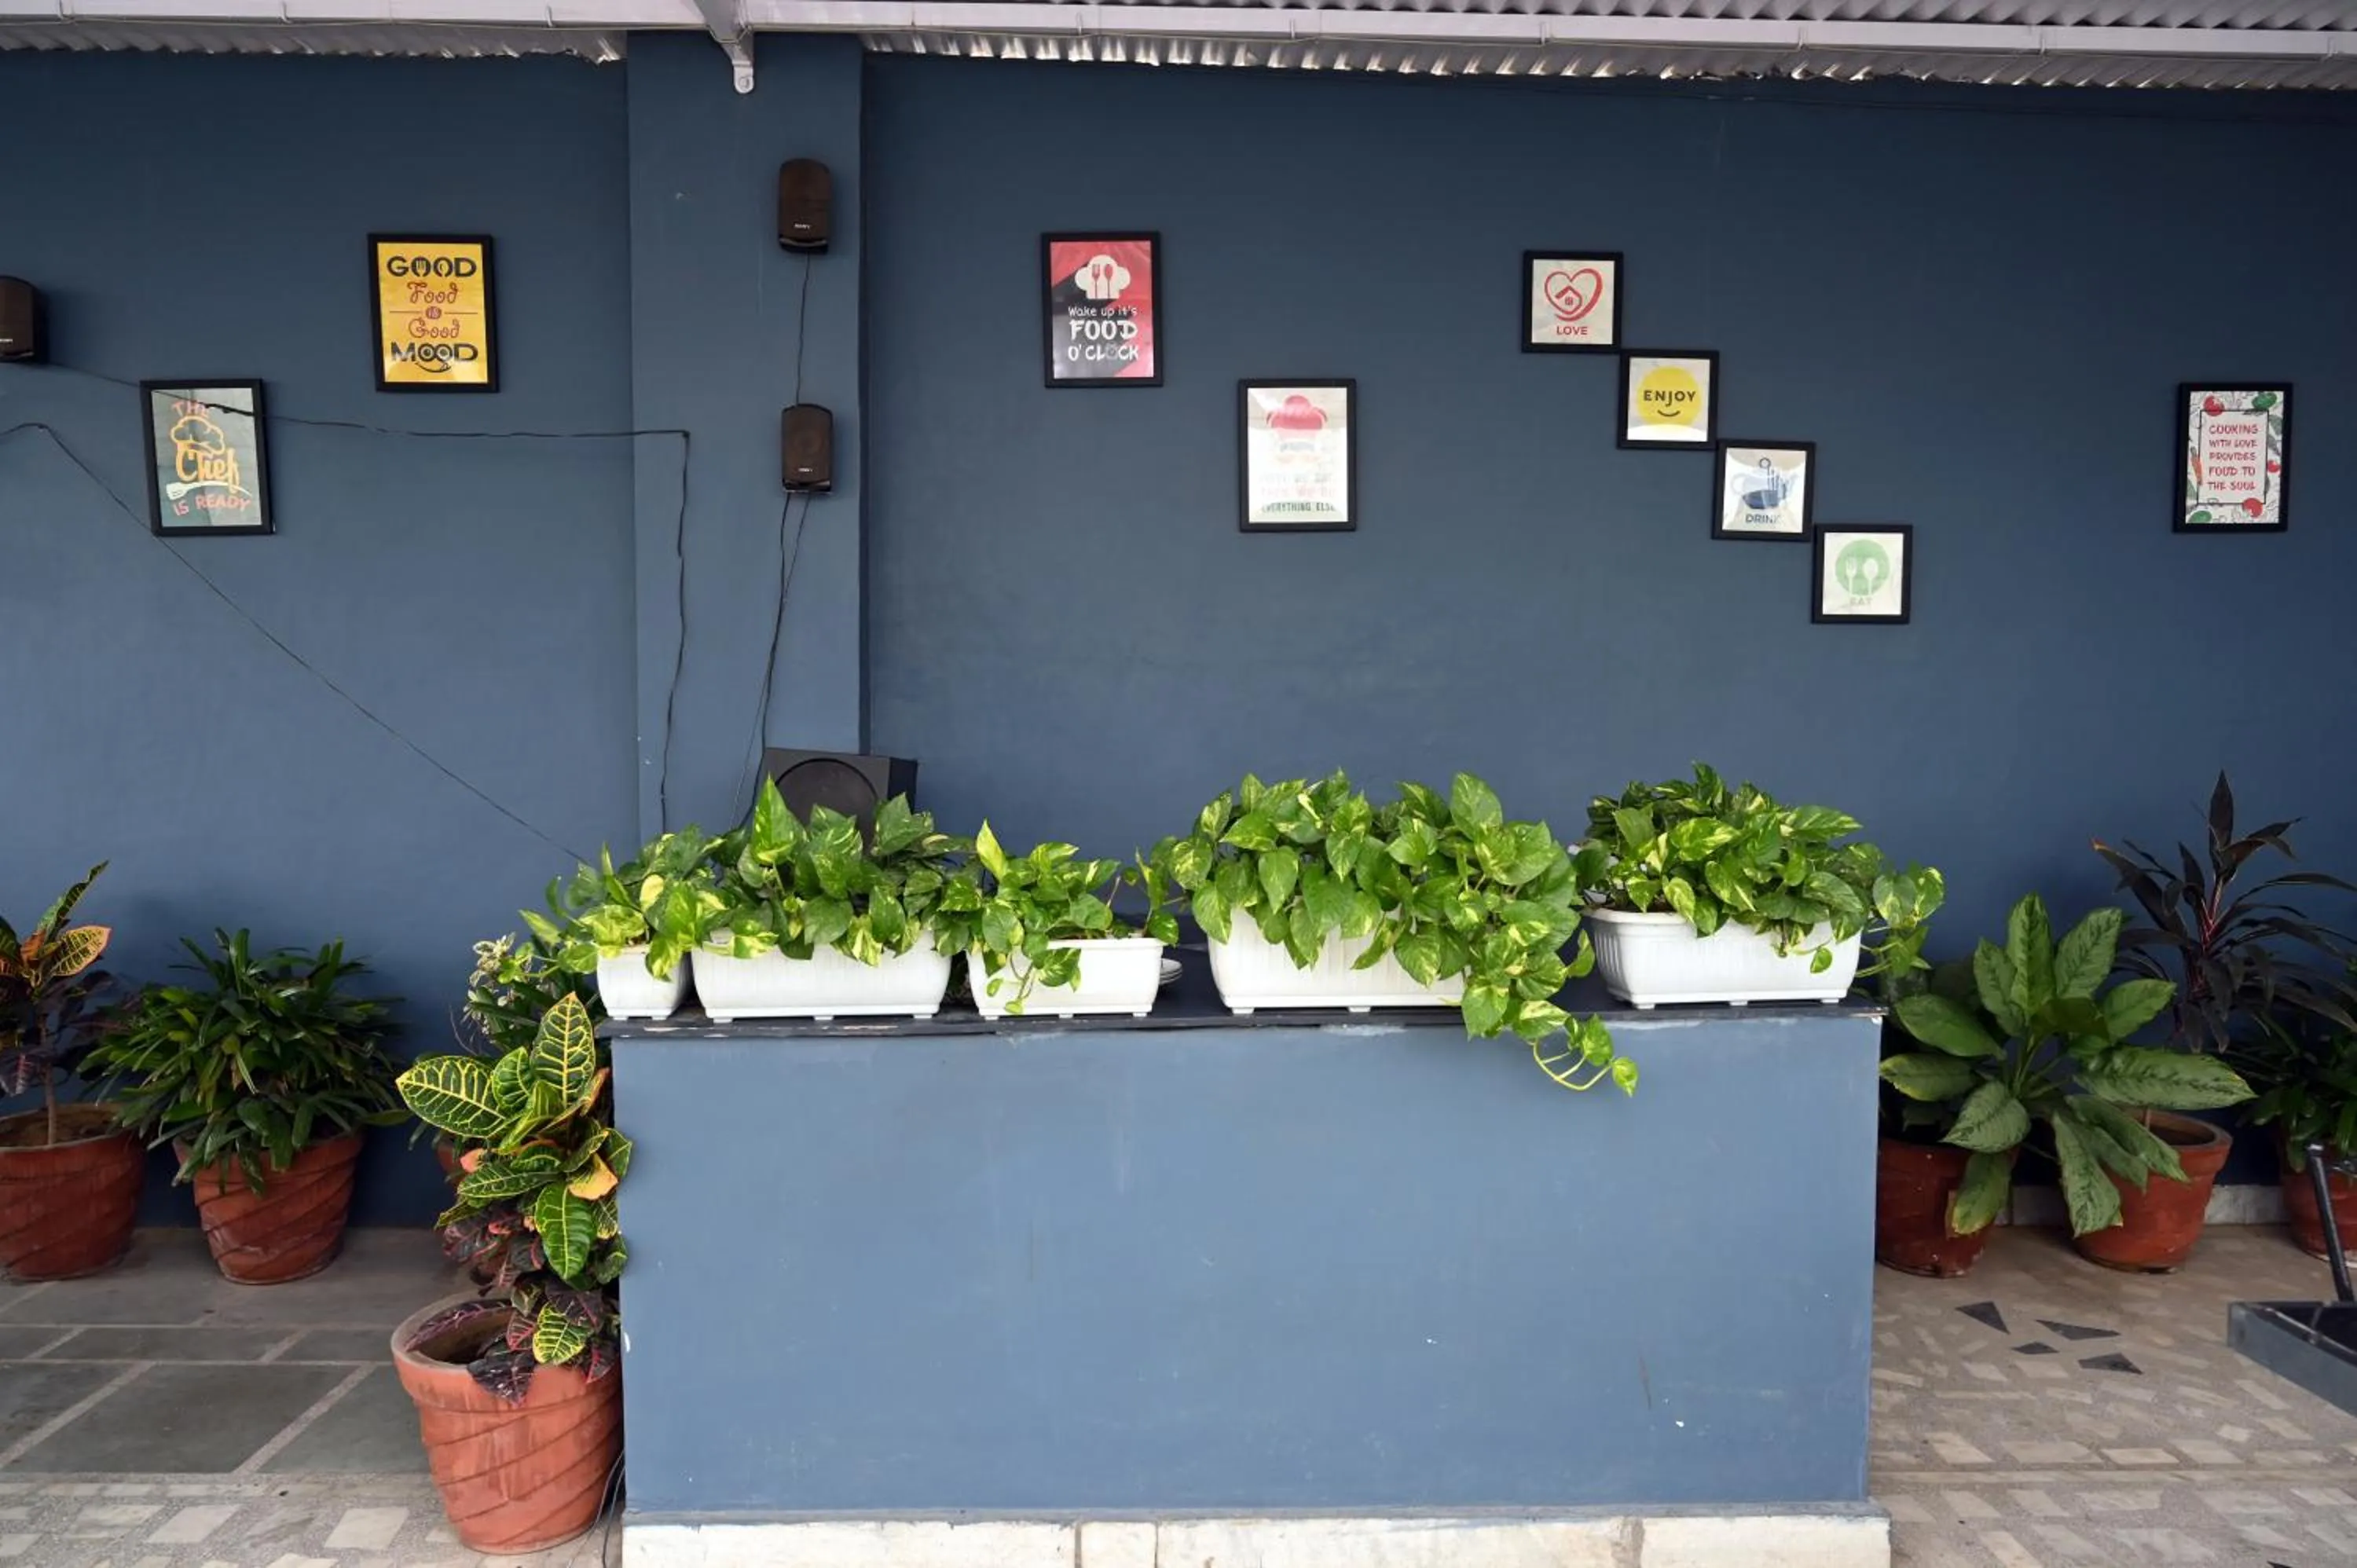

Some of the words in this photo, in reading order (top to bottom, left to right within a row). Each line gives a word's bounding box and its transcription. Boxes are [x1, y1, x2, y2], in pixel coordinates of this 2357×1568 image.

[387, 256, 477, 277] GOOD
[407, 280, 459, 304] Food
[1068, 306, 1096, 317] Wake
[1101, 308, 1115, 320] up
[1118, 305, 1138, 317] it's
[409, 317, 460, 339] Good
[1069, 320, 1138, 341] FOOD
[1556, 326, 1588, 335] LOVE
[390, 342, 478, 362] MOOD
[1068, 343, 1138, 361] O'CLOCK
[1643, 389, 1696, 408] ENJOY
[2209, 423, 2259, 435] COOKING
[2209, 438, 2231, 449] WITH
[2234, 438, 2258, 449] LOVE
[2209, 452, 2256, 461] PROVIDES
[175, 440, 240, 494] Chef
[2209, 466, 2238, 477] FOOD
[2242, 466, 2256, 477] TO
[2207, 481, 2227, 491] THE
[2231, 480, 2256, 492] SOUL
[195, 493, 251, 512] READY
